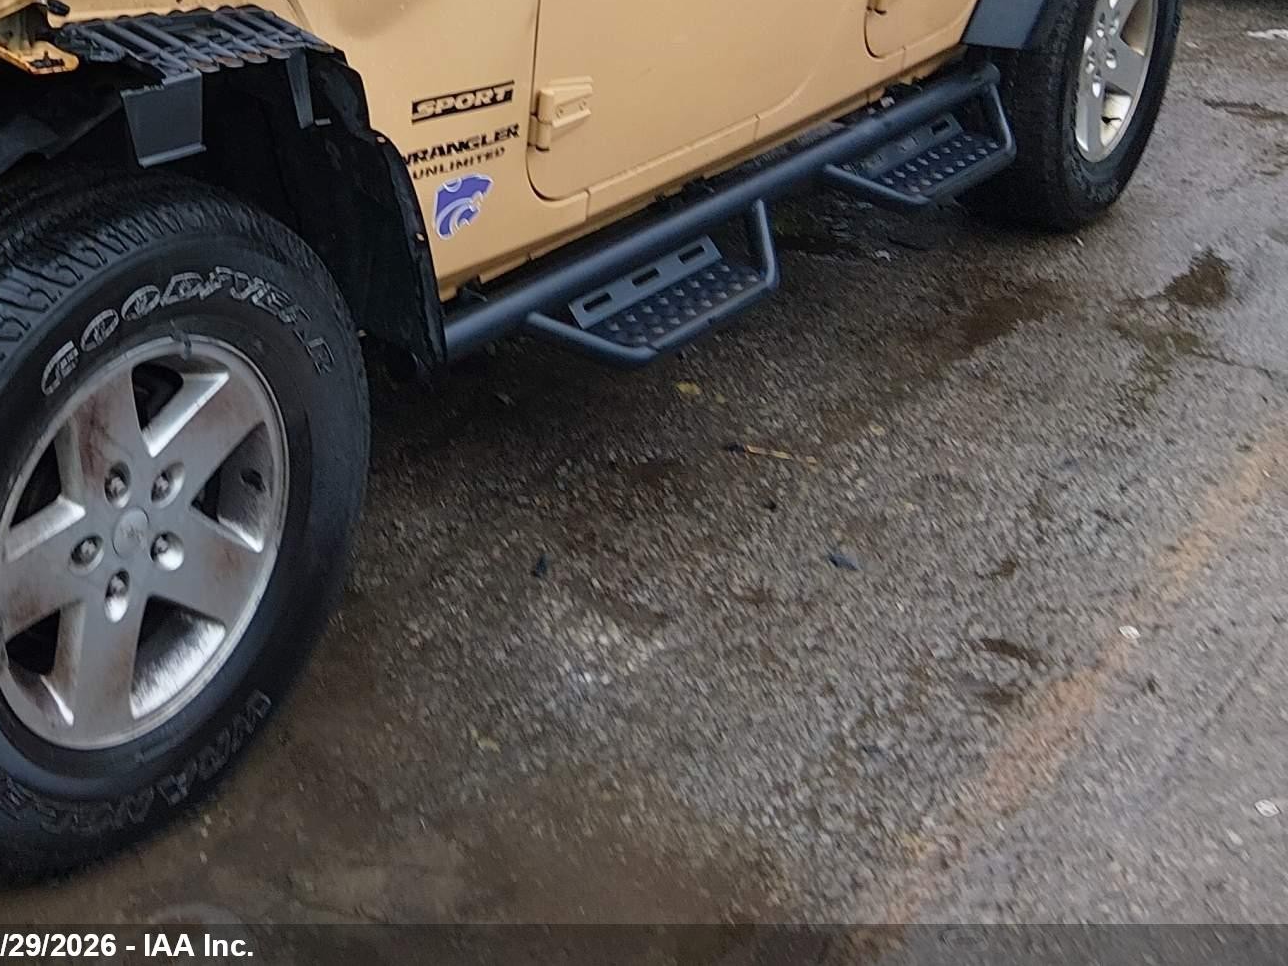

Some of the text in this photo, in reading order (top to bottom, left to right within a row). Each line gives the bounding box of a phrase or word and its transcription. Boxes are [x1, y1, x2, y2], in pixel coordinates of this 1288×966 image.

[413, 85, 514, 119] SPORT
[412, 146, 506, 180] UNLIMITED
[40, 266, 336, 396] GOODYEAR
